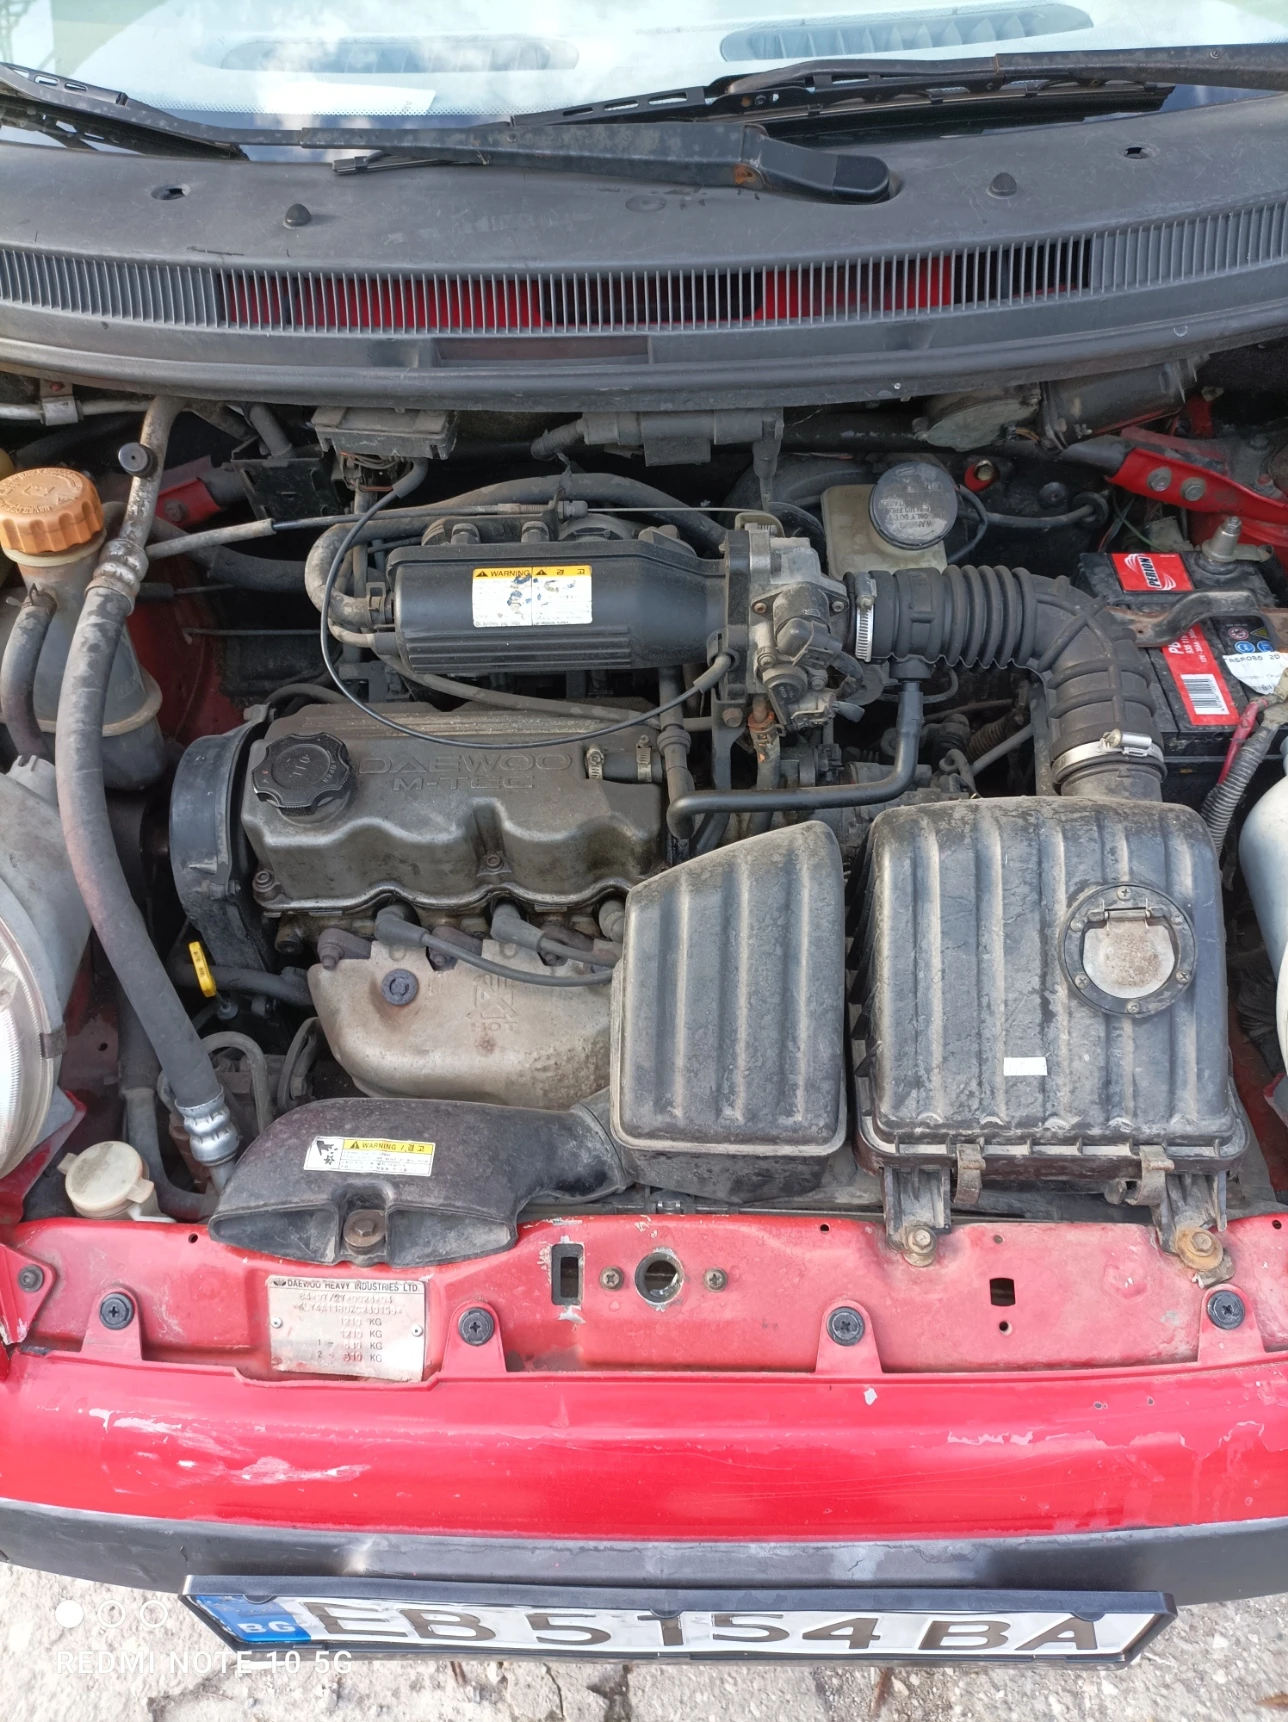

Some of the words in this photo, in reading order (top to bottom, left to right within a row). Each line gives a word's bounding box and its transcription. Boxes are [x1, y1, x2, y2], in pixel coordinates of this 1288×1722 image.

[490, 569, 530, 577] WARNING
[1138, 557, 1162, 588] PERION
[358, 752, 572, 774] DAEWOO
[393, 774, 535, 791] M-TEC
[362, 1142, 397, 1151] WARNING
[287, 1280, 321, 1289] DAEWOO
[324, 1281, 350, 1290] HEAVY
[354, 1281, 400, 1292] INDUSTRIES
[403, 1282, 420, 1293] LTD.
[368, 1317, 383, 1327] KG
[368, 1329, 383, 1339] KG
[369, 1341, 383, 1351] KG
[369, 1352, 383, 1363] KG
[238, 1621, 296, 1634] BG
[303, 1602, 496, 1641] EB
[523, 1611, 882, 1649] 5154
[918, 1616, 1099, 1650] BA
